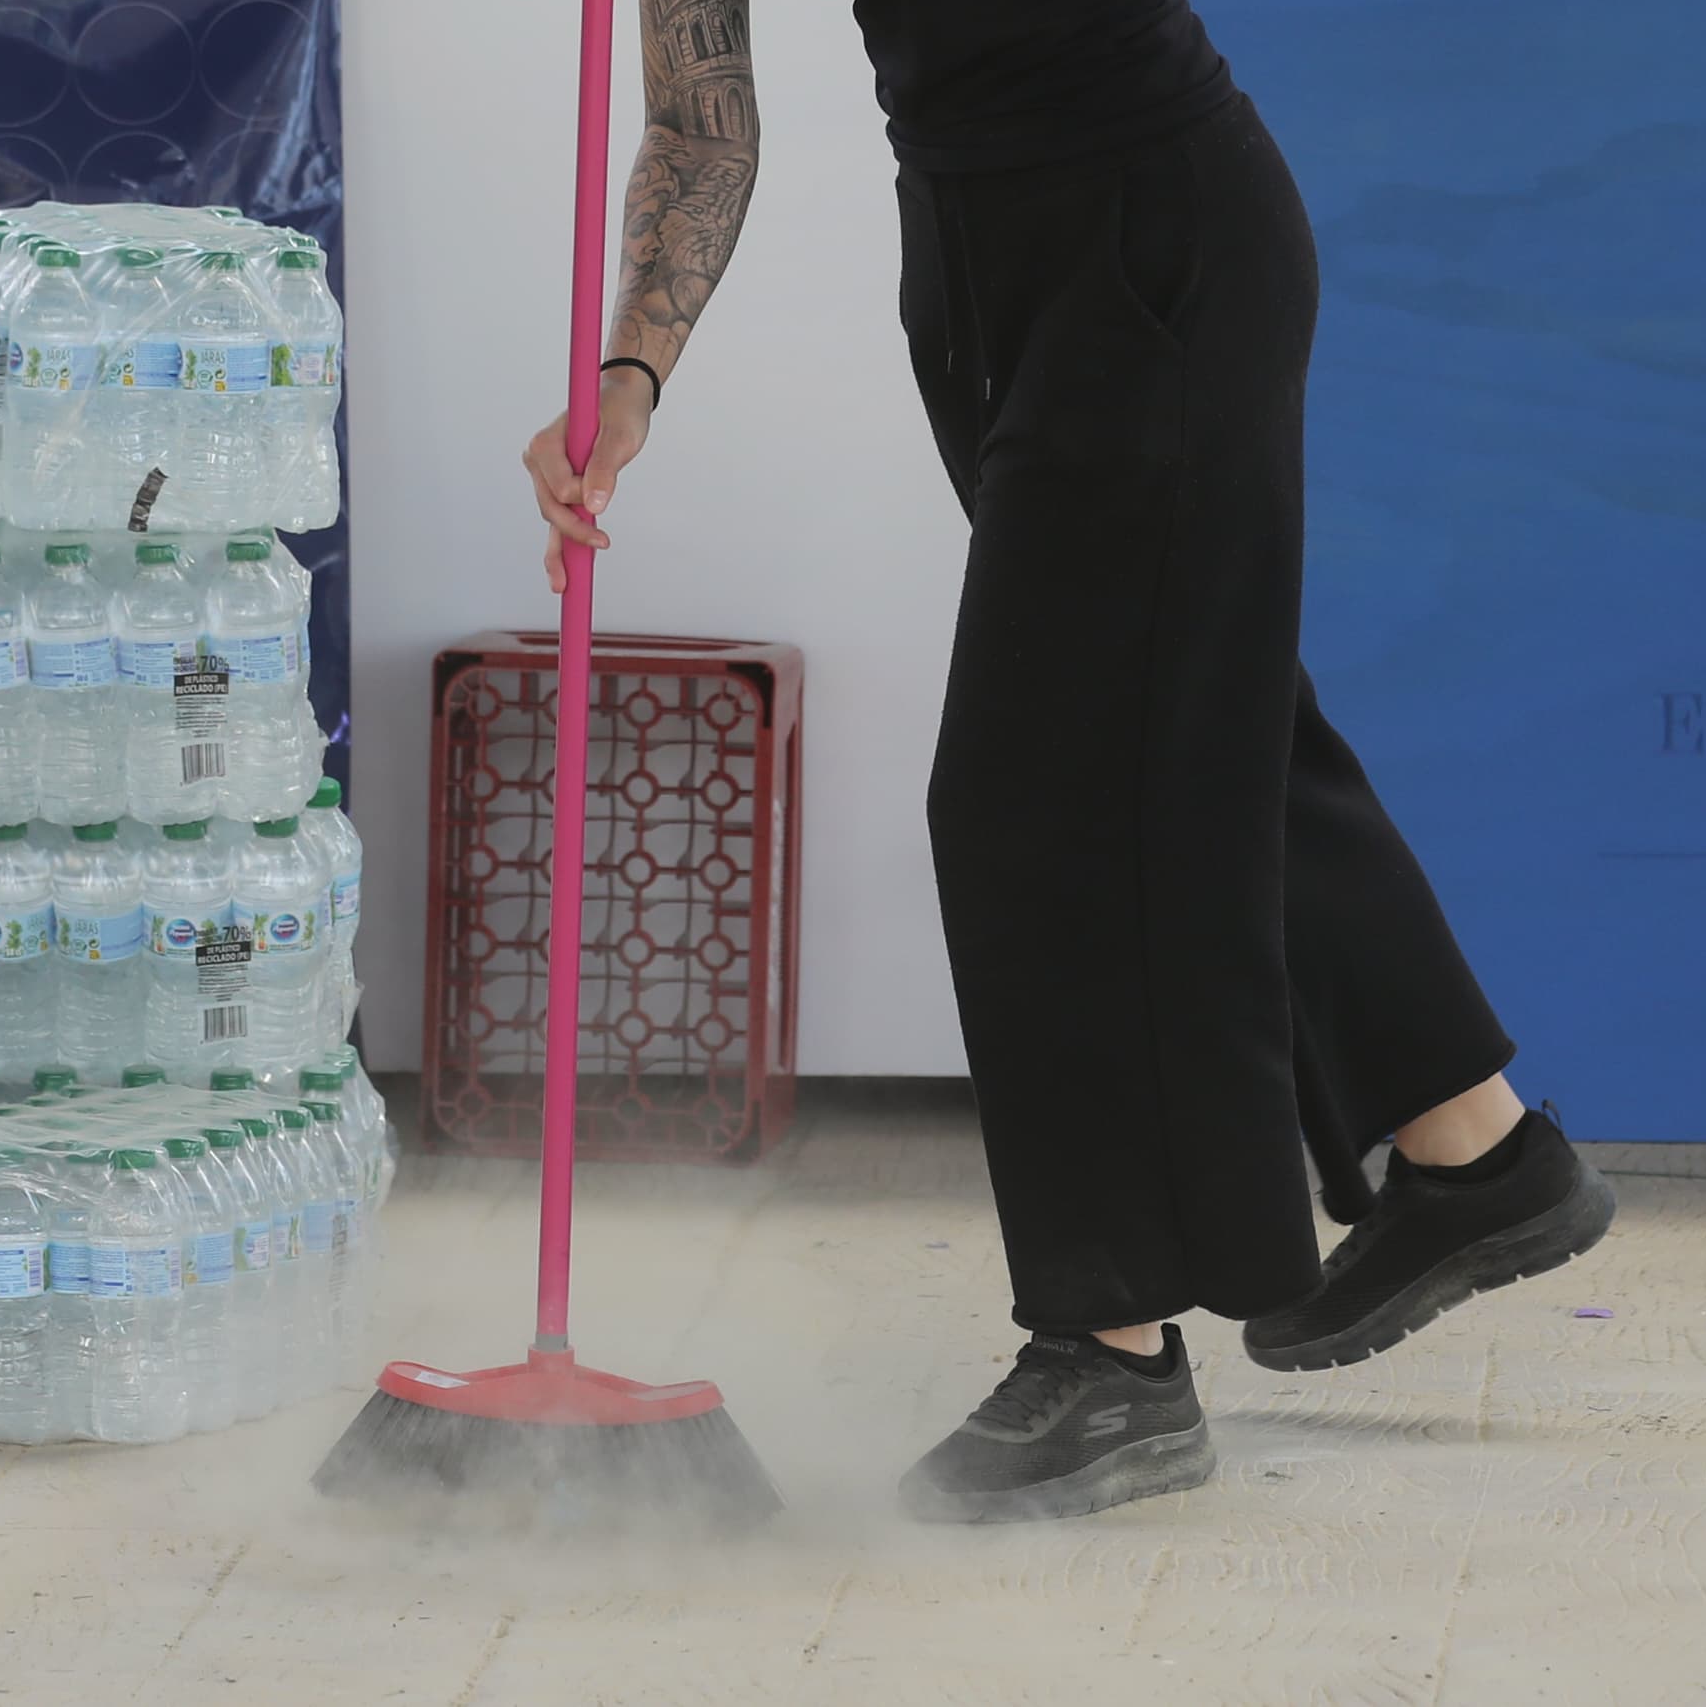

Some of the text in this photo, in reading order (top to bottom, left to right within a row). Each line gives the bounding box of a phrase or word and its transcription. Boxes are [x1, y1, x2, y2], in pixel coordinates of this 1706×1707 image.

[199, 655, 230, 672] 70%
[176, 684, 213, 694] RECICLADO
[223, 925, 252, 942] 70%
[198, 953, 236, 965] RECICLADO
